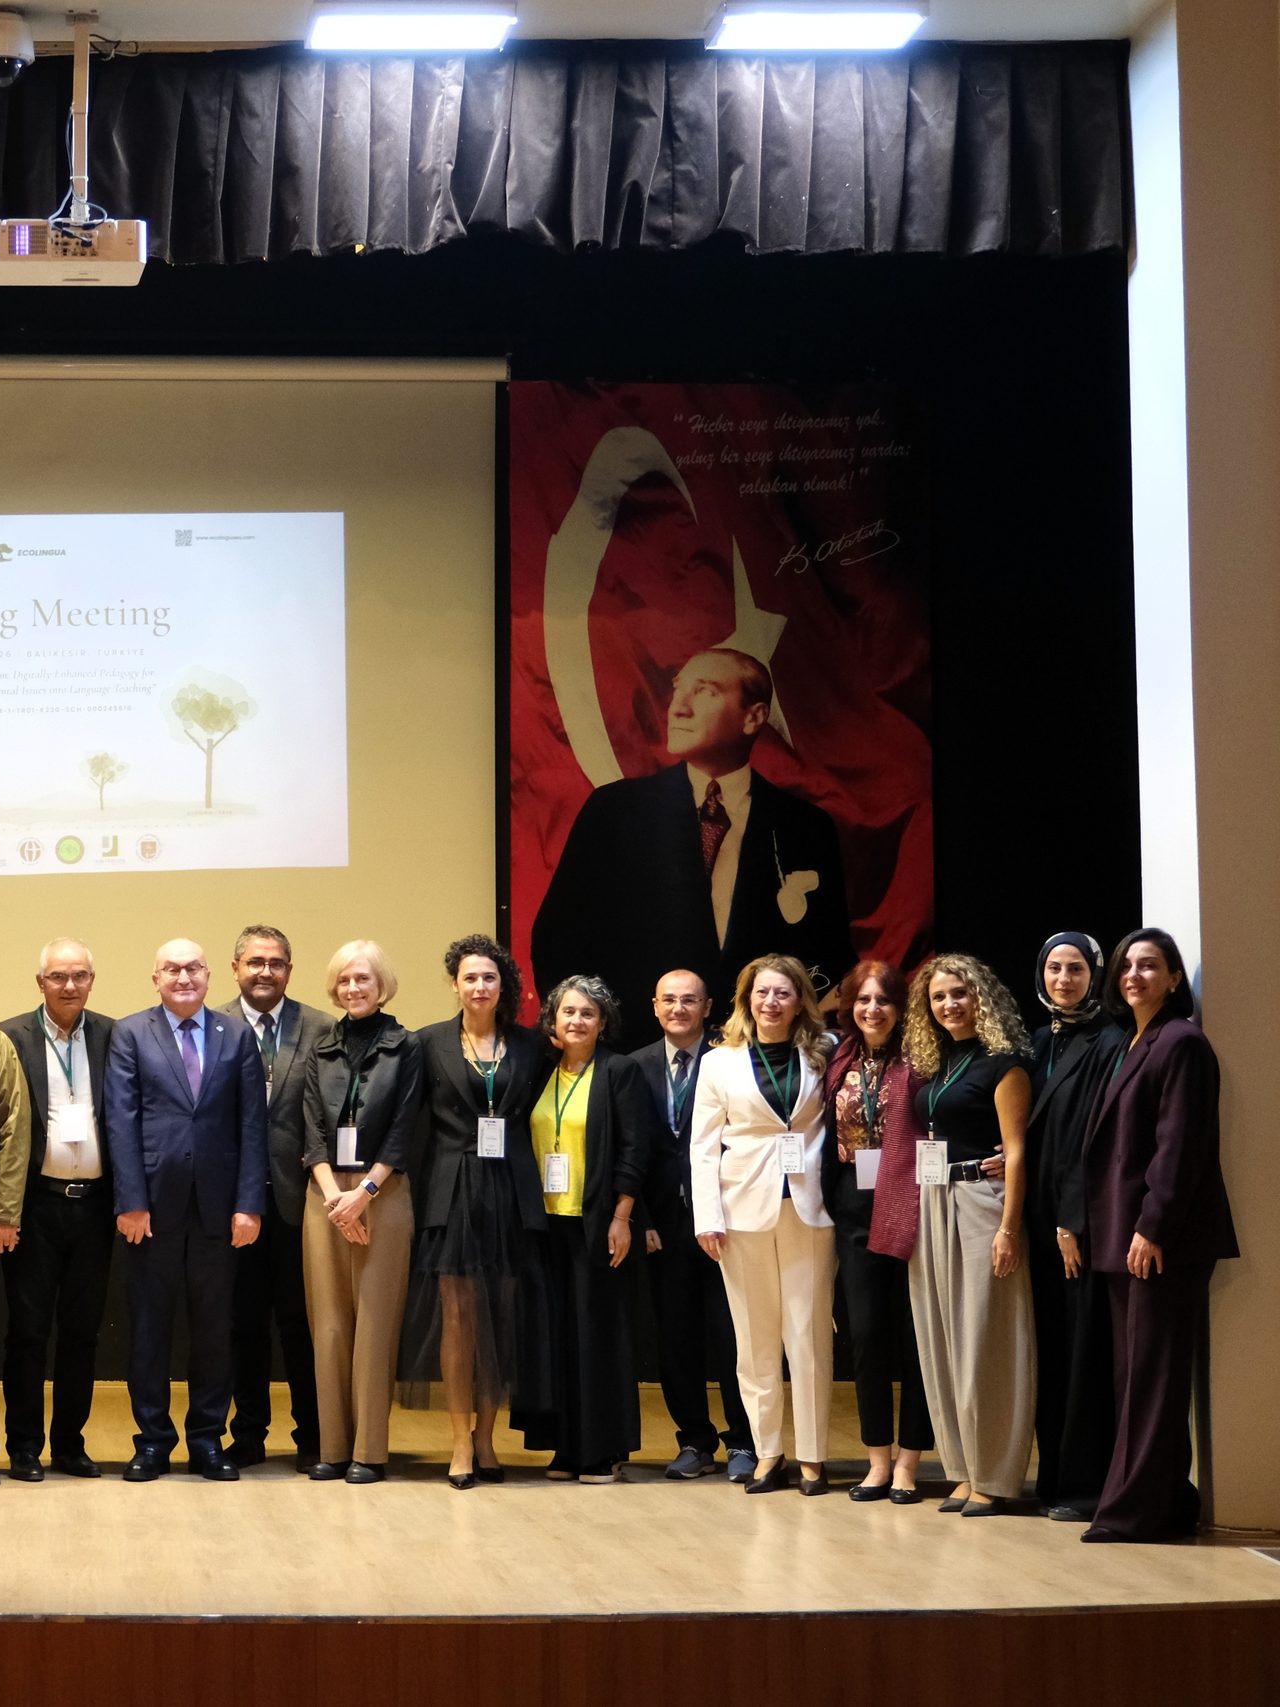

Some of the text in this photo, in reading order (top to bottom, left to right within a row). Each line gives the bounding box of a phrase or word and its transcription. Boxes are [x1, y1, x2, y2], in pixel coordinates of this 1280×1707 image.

[738, 417, 769, 437] şeye
[773, 411, 851, 434] ihtiyacımız
[719, 445, 740, 463] bir
[743, 450, 774, 466] şeye
[778, 443, 856, 464] ihtiyacımız
[738, 475, 801, 499] çalışkan
[17, 548, 66, 557] ECOLINGUA
[31, 598, 171, 637] Meeting
[140, 666, 155, 680] for
